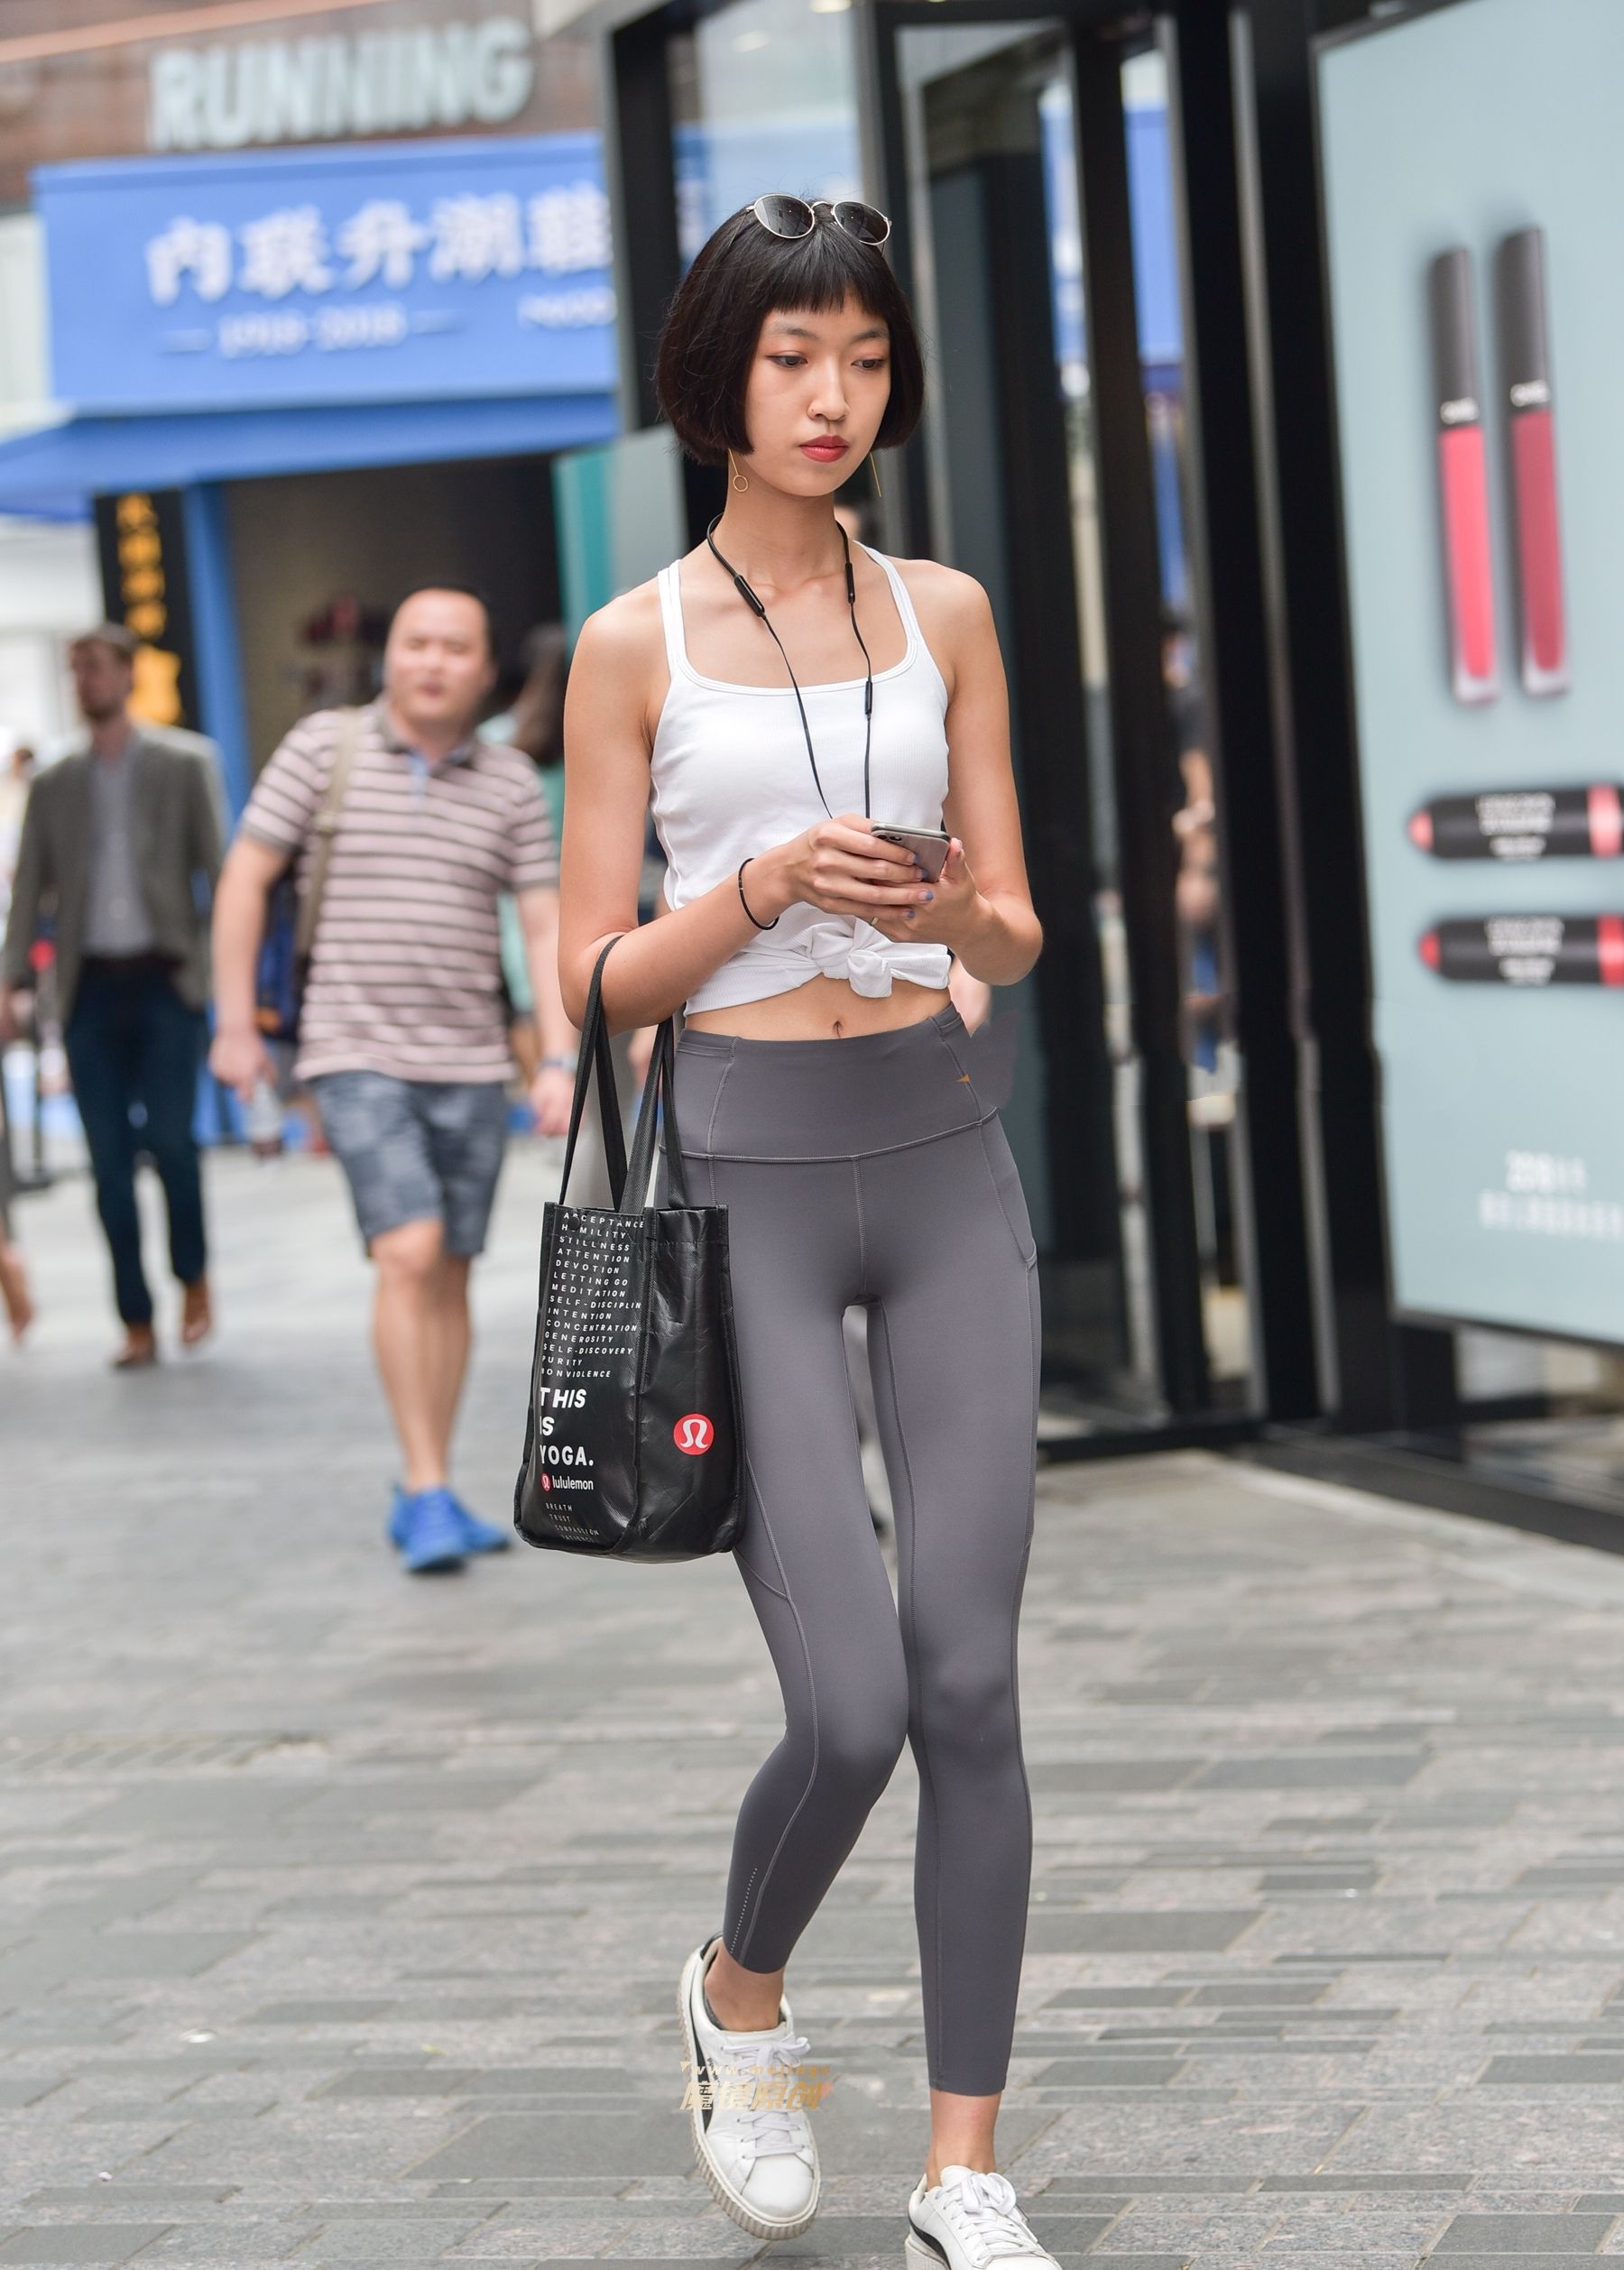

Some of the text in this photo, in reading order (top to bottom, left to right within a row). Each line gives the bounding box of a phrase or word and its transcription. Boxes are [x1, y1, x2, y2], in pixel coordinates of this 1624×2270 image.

[149, 17, 531, 152] RUNNING
[564, 1213, 644, 1228] ACEPTANCE
[562, 1224, 626, 1239] HMILITY
[559, 1236, 630, 1251] STILLNESS
[558, 1248, 630, 1263] ATTENTION
[556, 1260, 620, 1274] DEVOTION
[554, 1272, 609, 1286] LETTING
[551, 1283, 626, 1297] MEDITATION
[549, 1296, 641, 1308] SELF-DISCIPLIN
[548, 1307, 612, 1320] INTENTION
[547, 1320, 637, 1332] CONCENTRATION
[545, 1332, 614, 1343] GENEROSITY
[543, 1343, 633, 1354] SELF-DISCOVERY
[540, 1387, 587, 1408] THIS
[540, 1444, 594, 1466] YOGA.
[551, 1475, 594, 1490] lululemon
[545, 1502, 573, 1512] BREATH
[549, 1513, 570, 1522] TRUST
